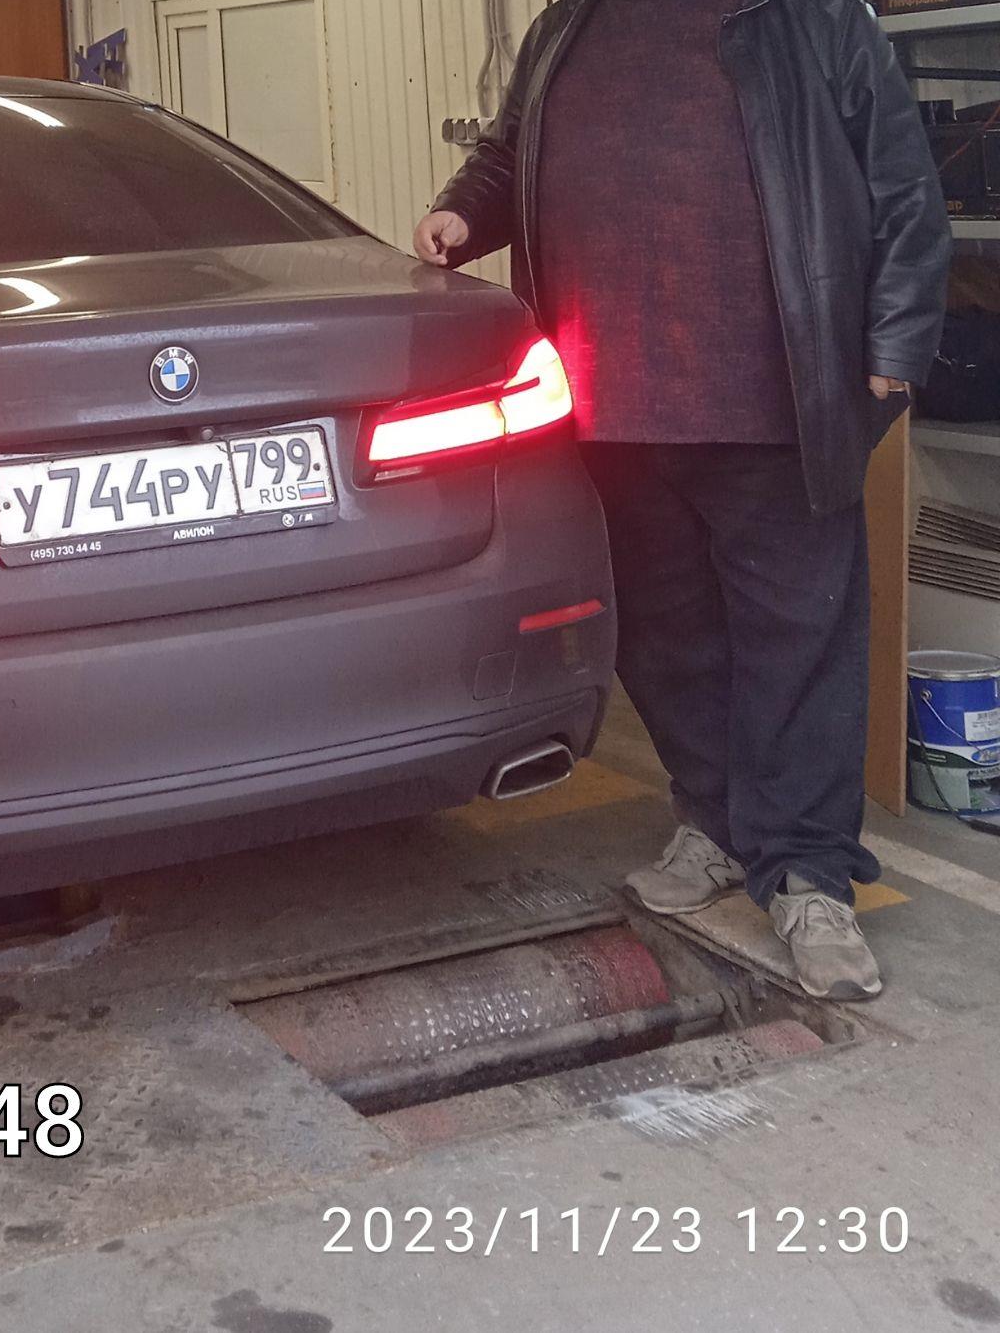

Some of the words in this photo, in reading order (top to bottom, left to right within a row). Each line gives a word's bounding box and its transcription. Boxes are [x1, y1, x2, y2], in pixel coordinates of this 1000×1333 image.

[155, 349, 194, 368] BMW
[233, 438, 311, 489] 799
[259, 485, 298, 504] RUS
[173, 525, 215, 540] АВИЛОН
[30, 546, 55, 561] (495)
[56, 545, 74, 556] 730
[75, 543, 88, 553] 44
[89, 541, 102, 552] 45
